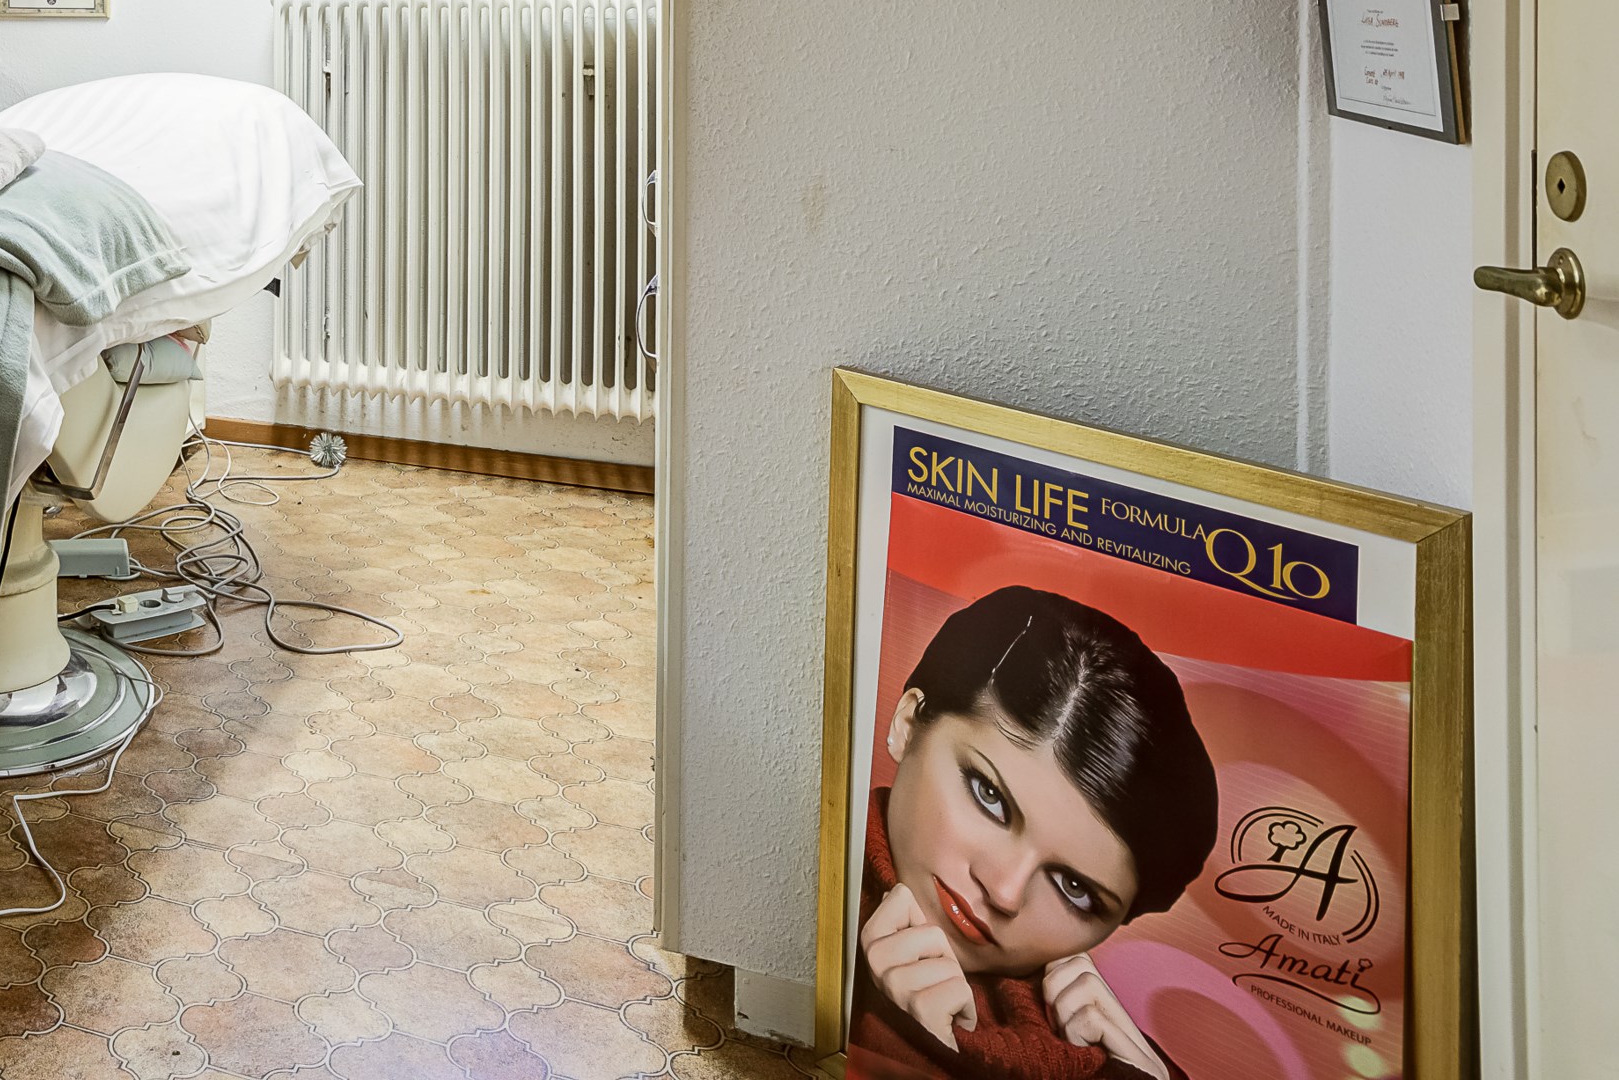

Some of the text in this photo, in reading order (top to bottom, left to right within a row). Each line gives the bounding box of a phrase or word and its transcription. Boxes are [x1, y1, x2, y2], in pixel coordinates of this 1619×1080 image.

[907, 446, 998, 505] SKIN
[1014, 473, 1089, 531] LIFE
[1101, 498, 1208, 542] FORMULA
[907, 482, 1191, 576] MAXIMAL MOISTURIZING AND REVITALIZING
[1263, 905, 1341, 946] MADE IN ITALY
[1218, 933, 1378, 994] Amati
[1250, 983, 1372, 1047] PROFESSIONAL MAKEUP
